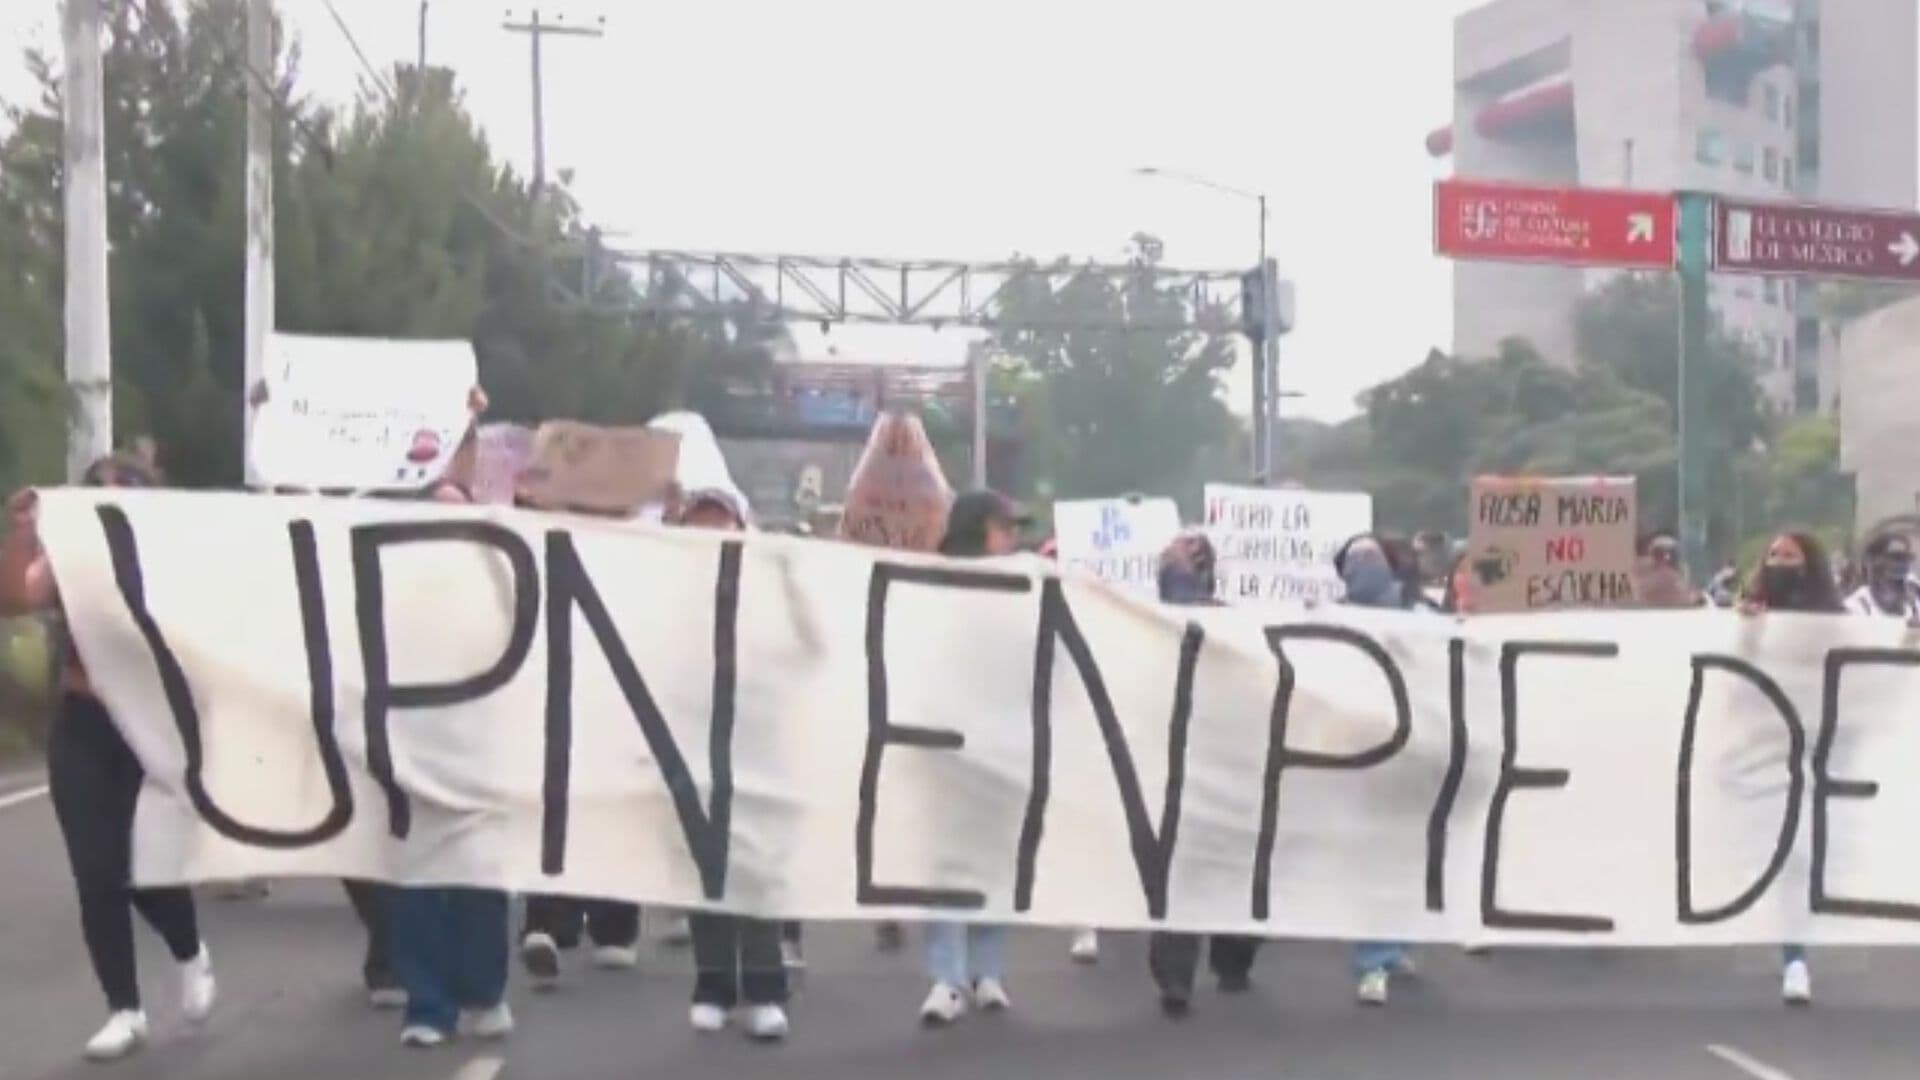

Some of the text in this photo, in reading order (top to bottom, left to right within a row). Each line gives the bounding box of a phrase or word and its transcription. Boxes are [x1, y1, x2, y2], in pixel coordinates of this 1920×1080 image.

[1545, 533, 1584, 564] NO
[97, 504, 743, 900] UPN
[856, 562, 1205, 920] EN
[1252, 623, 1620, 932] PIE
